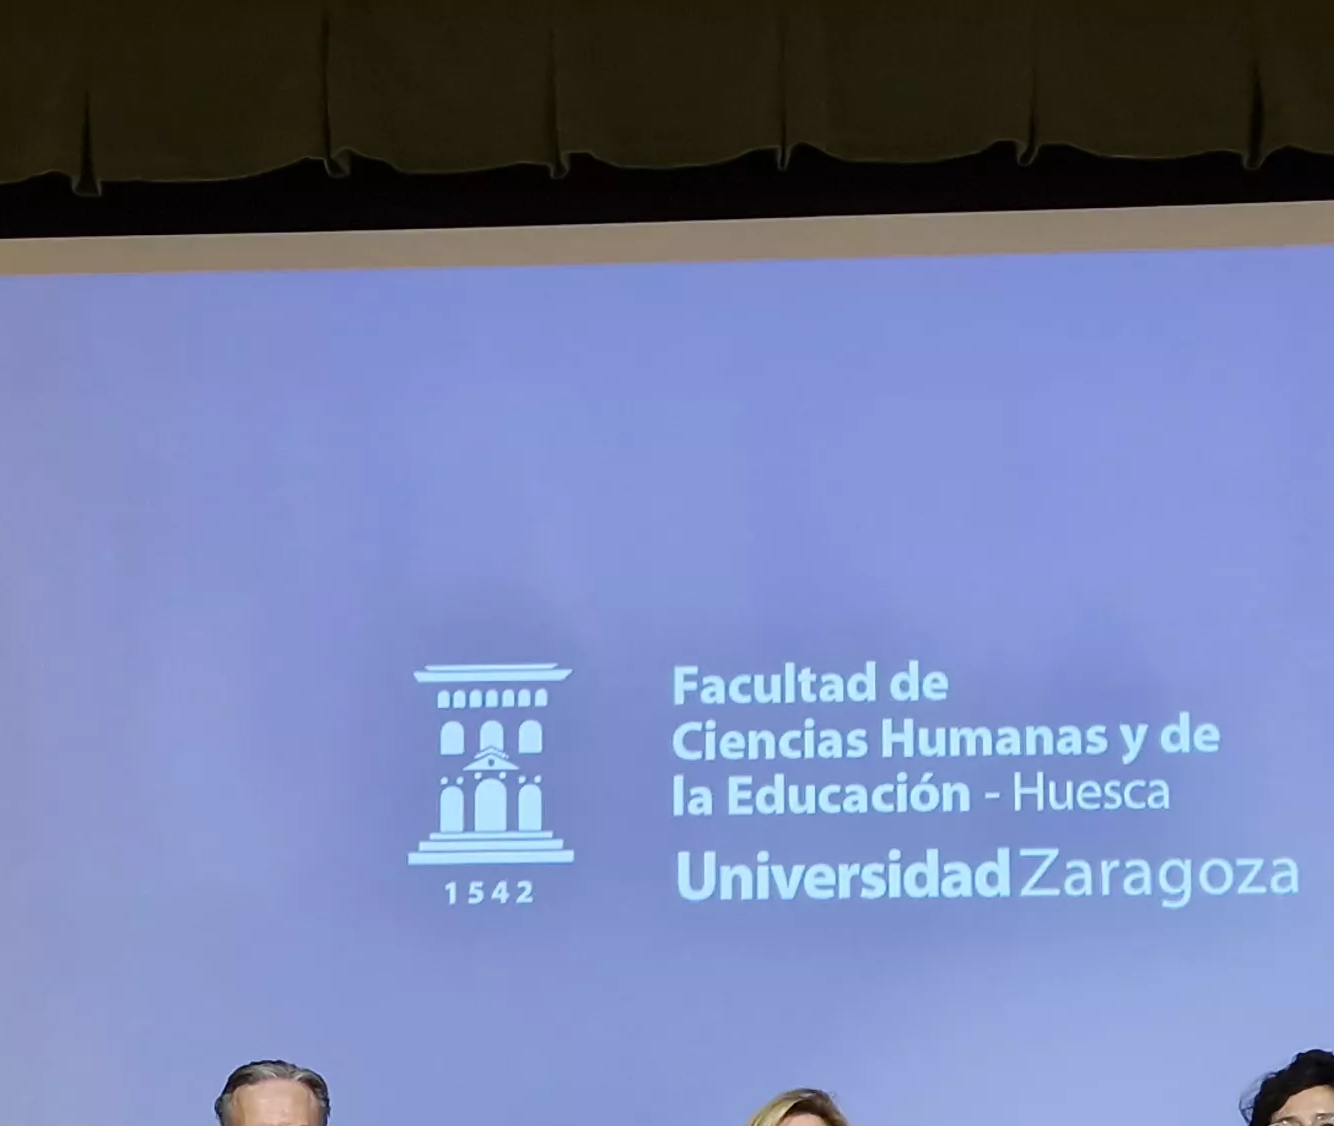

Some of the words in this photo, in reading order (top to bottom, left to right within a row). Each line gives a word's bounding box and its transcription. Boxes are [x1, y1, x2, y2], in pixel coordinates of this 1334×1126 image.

[673, 661, 877, 706] Facultad
[889, 660, 949, 702] de
[672, 718, 869, 761] Ciencias
[881, 717, 1108, 758] Humanas
[1118, 723, 1149, 765] y
[1160, 711, 1221, 754] de
[672, 774, 713, 817] la
[727, 771, 971, 816] Educación
[1013, 771, 1170, 812] Huesca
[444, 880, 534, 905] 1542
[677, 847, 1011, 902] Universidad
[1019, 847, 1299, 909] Zaragoza
